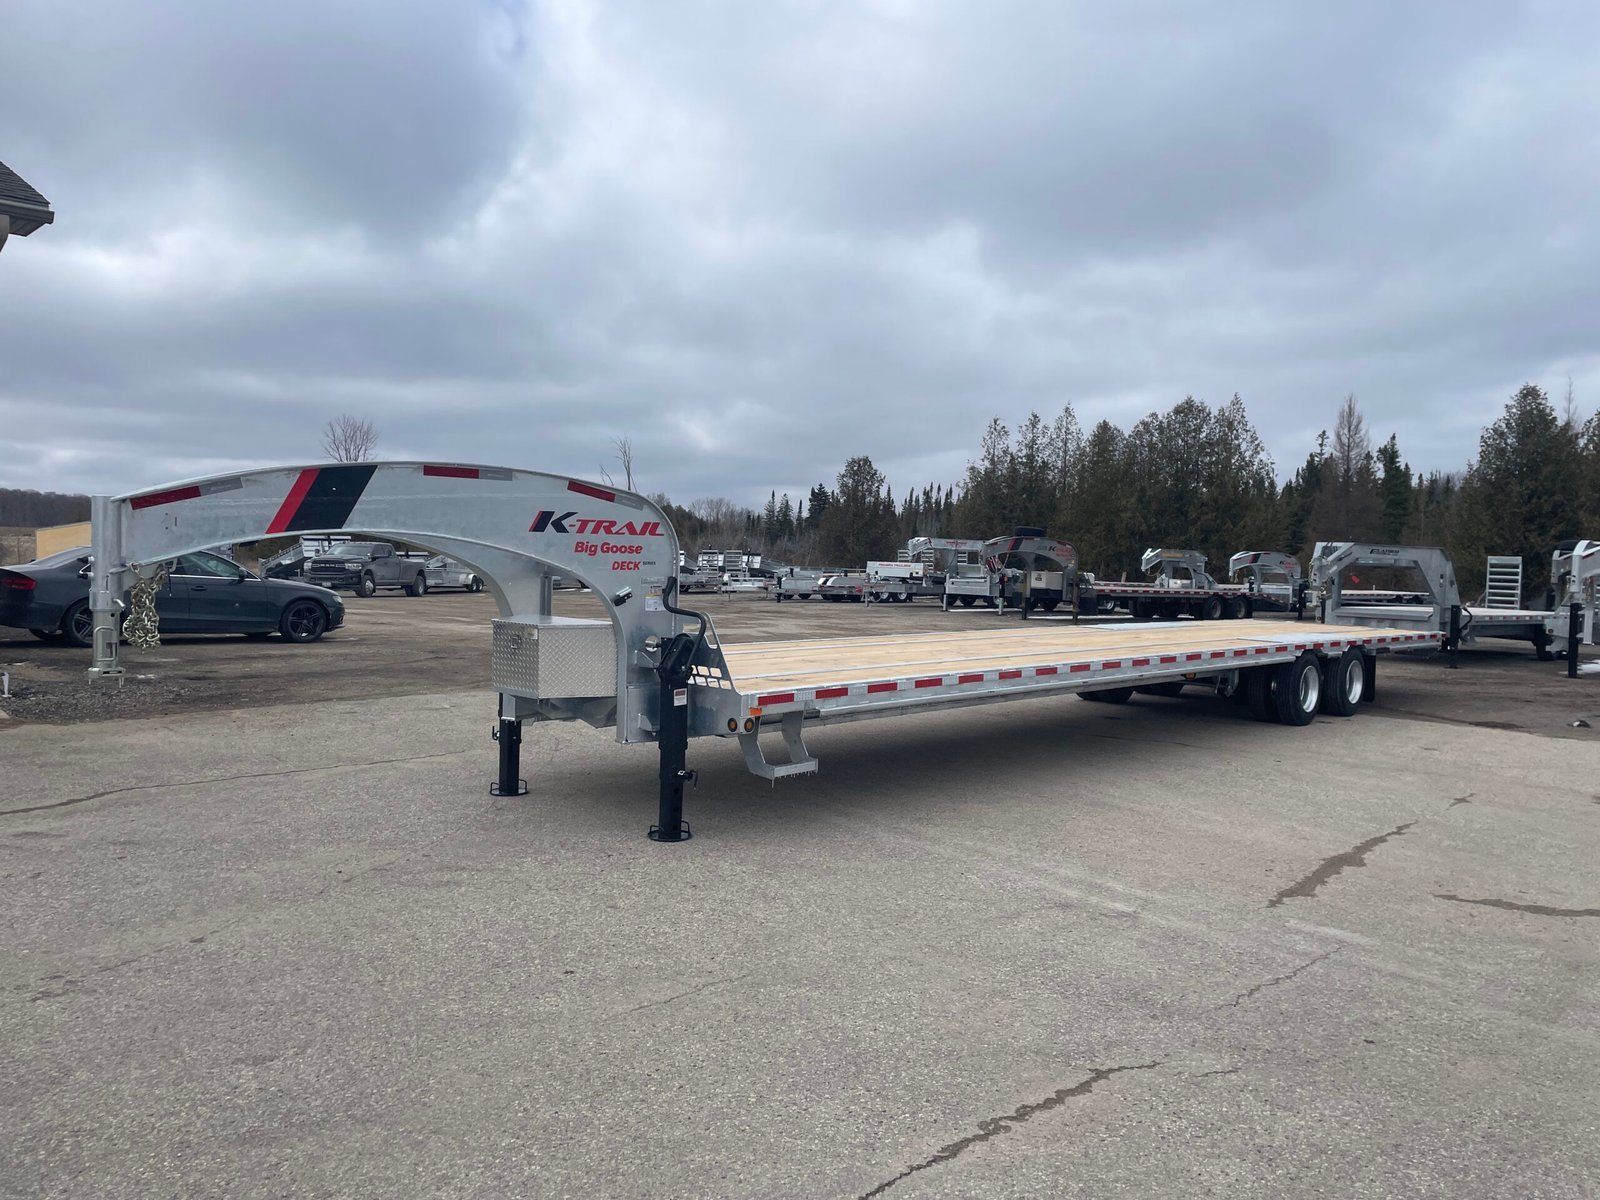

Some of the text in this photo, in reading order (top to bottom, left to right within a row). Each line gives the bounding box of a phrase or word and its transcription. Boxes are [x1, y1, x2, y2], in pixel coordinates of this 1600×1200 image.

[528, 510, 665, 537] K-TRAIL
[574, 541, 644, 556] Big Goose
[611, 561, 641, 571] DECK
